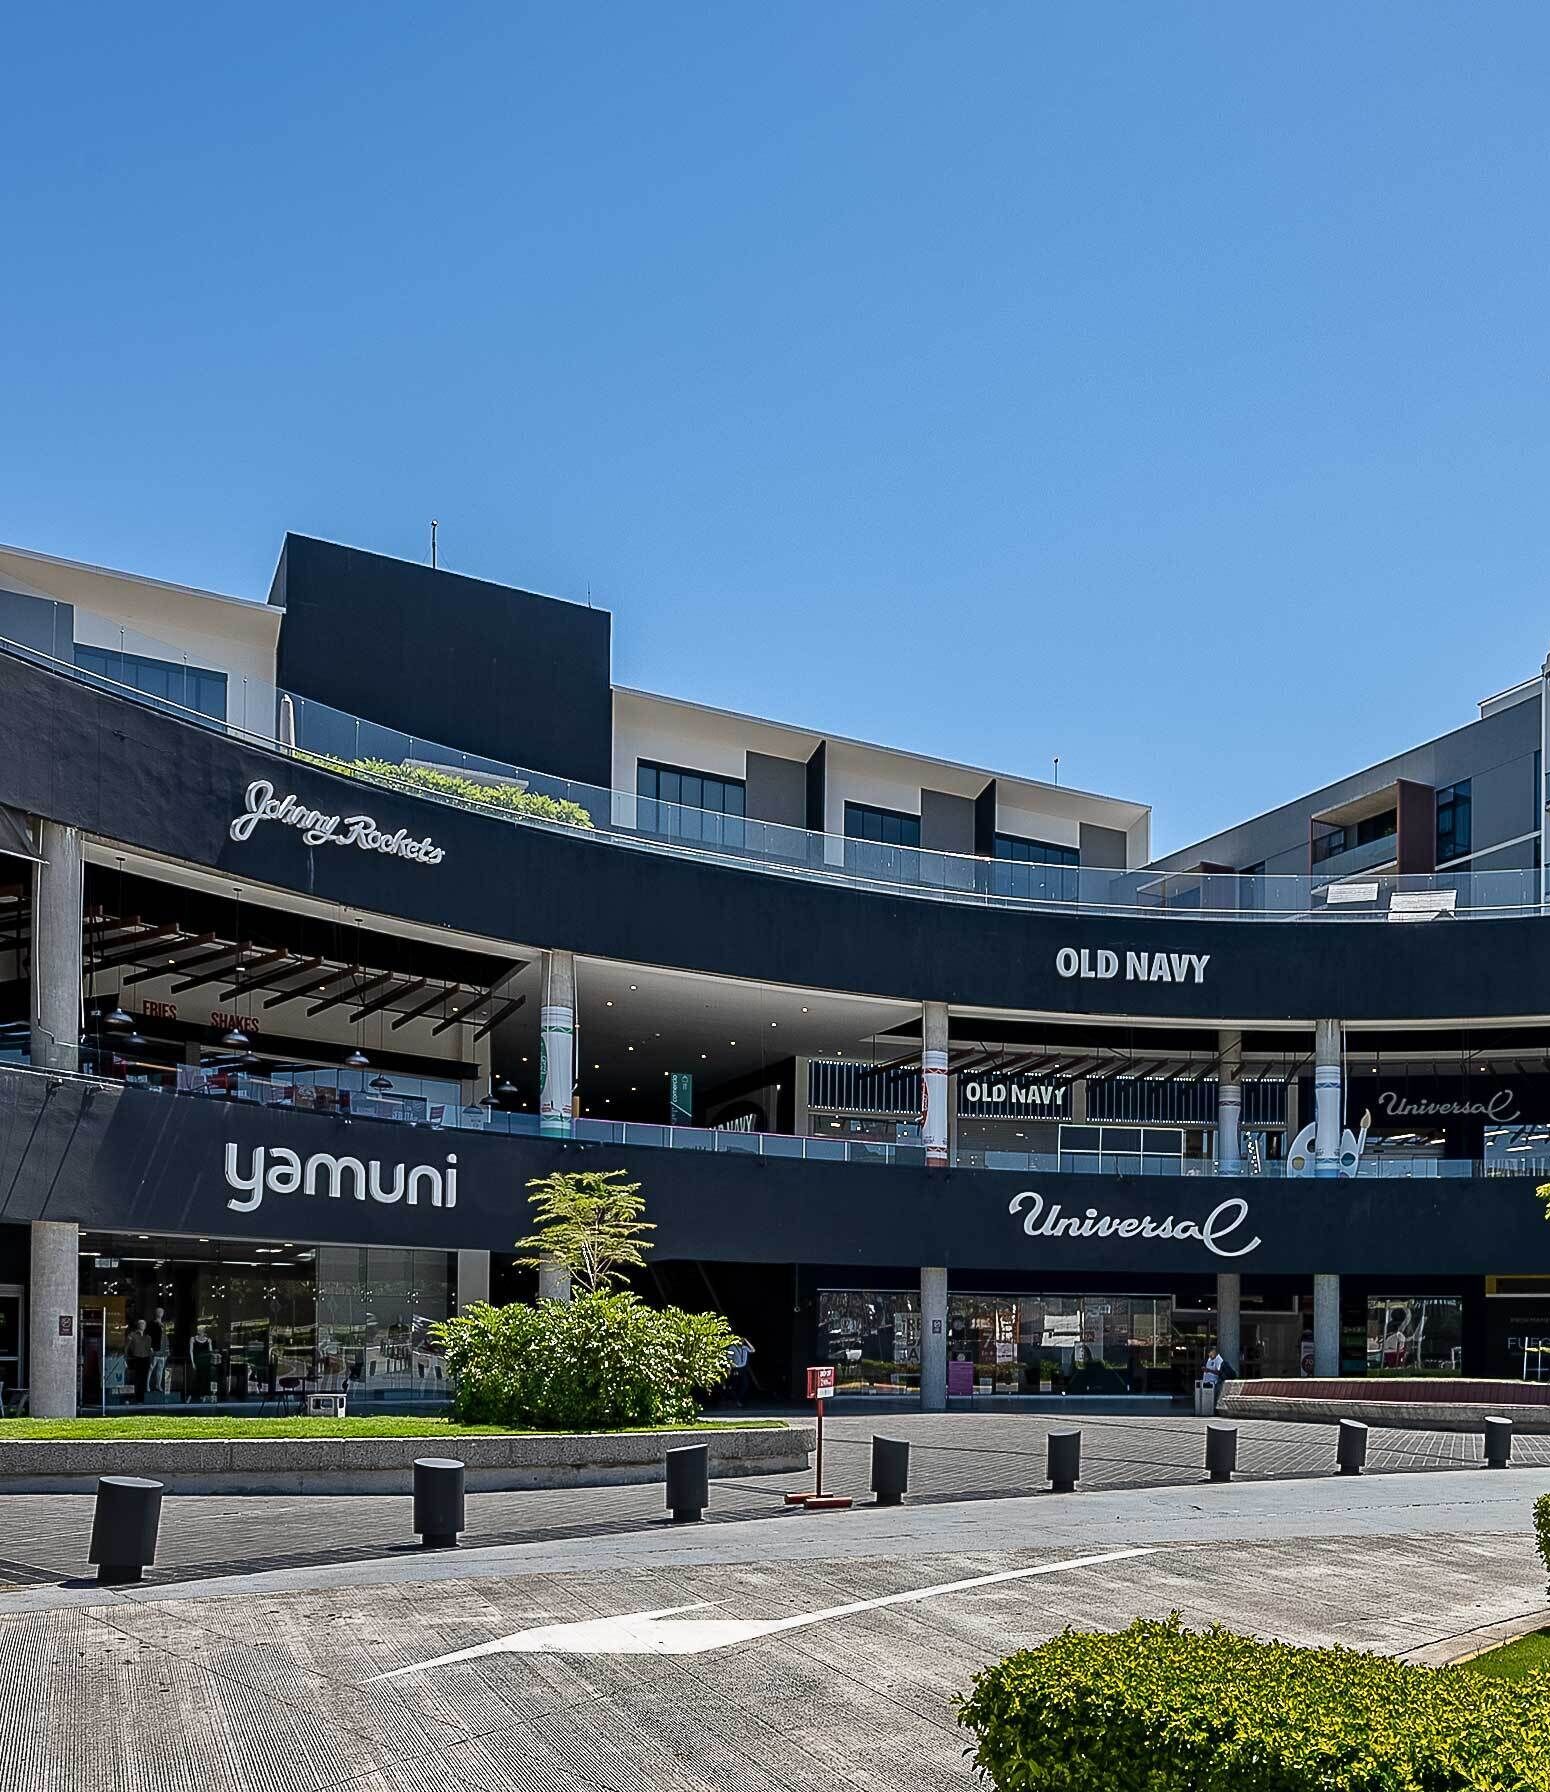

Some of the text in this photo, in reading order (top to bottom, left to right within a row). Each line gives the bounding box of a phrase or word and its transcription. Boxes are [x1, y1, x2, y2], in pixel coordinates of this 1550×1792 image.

[230, 780, 446, 864] Johnny Rockets
[1056, 947, 1211, 984] OLD NAVY
[143, 1000, 260, 1033] FRIES SHAKES
[966, 1082, 1067, 1105] OLD NAVY
[1378, 1089, 1521, 1122] Universal
[225, 1142, 457, 1213] yamuni
[1008, 1191, 1262, 1257] Universal
